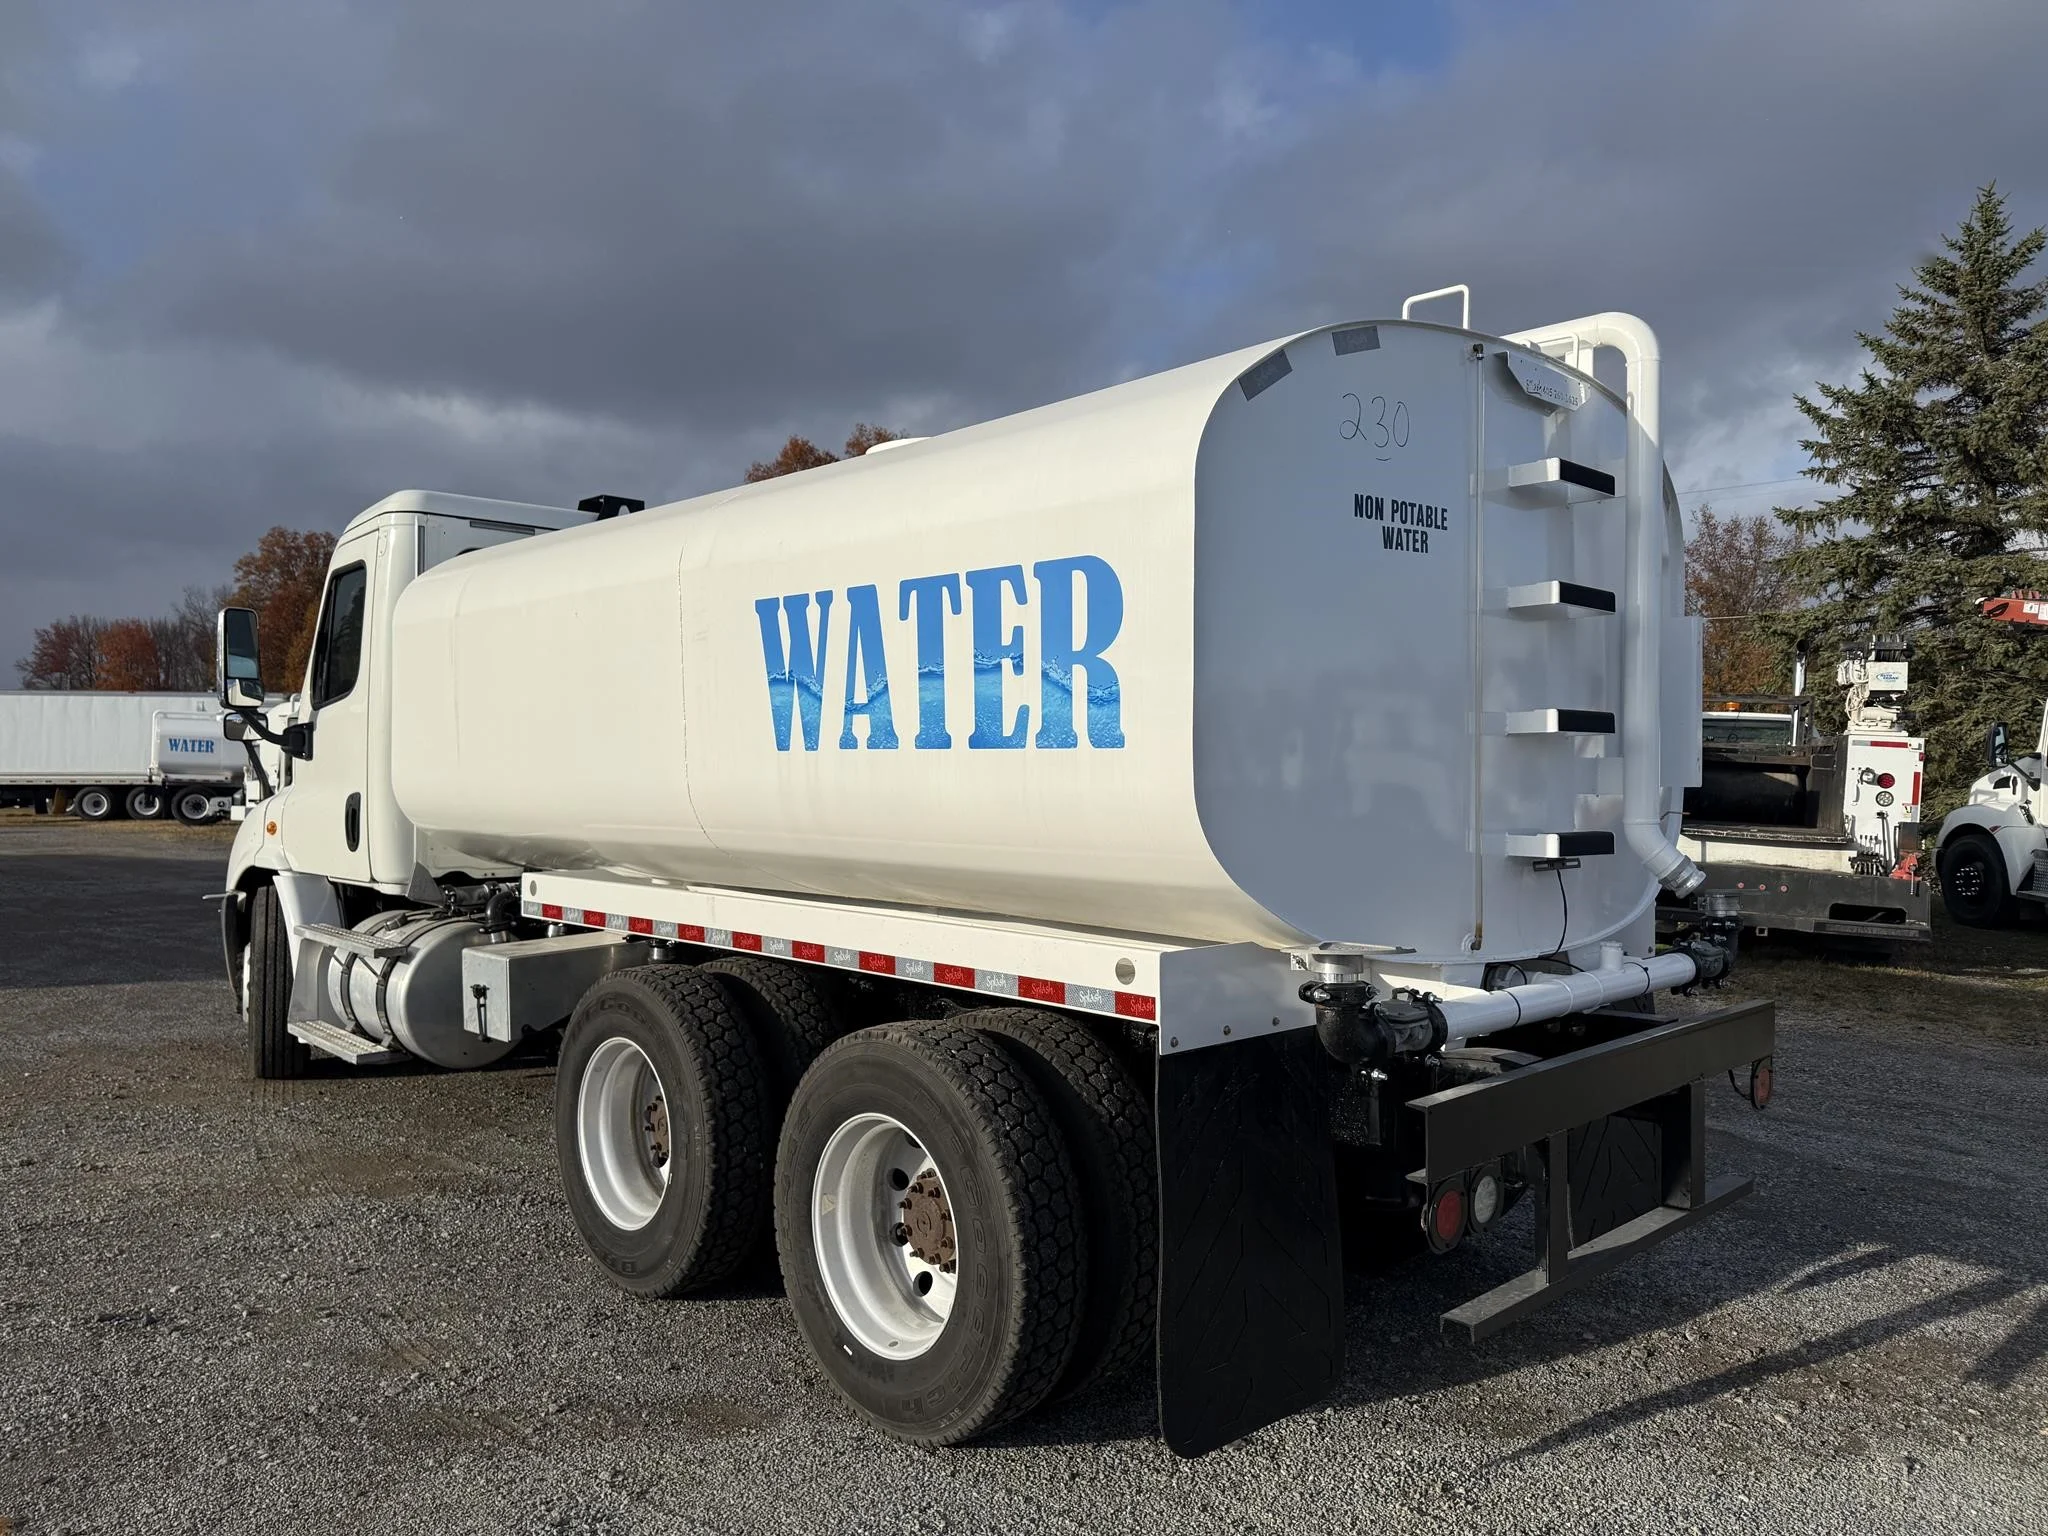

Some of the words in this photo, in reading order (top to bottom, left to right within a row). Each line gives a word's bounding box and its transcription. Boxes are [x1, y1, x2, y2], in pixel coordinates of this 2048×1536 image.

[1340, 393, 1410, 448] 230
[1354, 493, 1384, 521] NON
[1391, 499, 1448, 531] POTABLE
[1382, 525, 1429, 554] WATER
[754, 554, 1126, 752] WATER
[168, 738, 215, 754] WATER
[905, 962, 924, 977] Splash
[944, 969, 964, 983] Splash
[986, 975, 1007, 991] Splash
[1031, 983, 1054, 998] Splash
[1079, 990, 1102, 1007] Splash
[1130, 999, 1156, 1017] Splash
